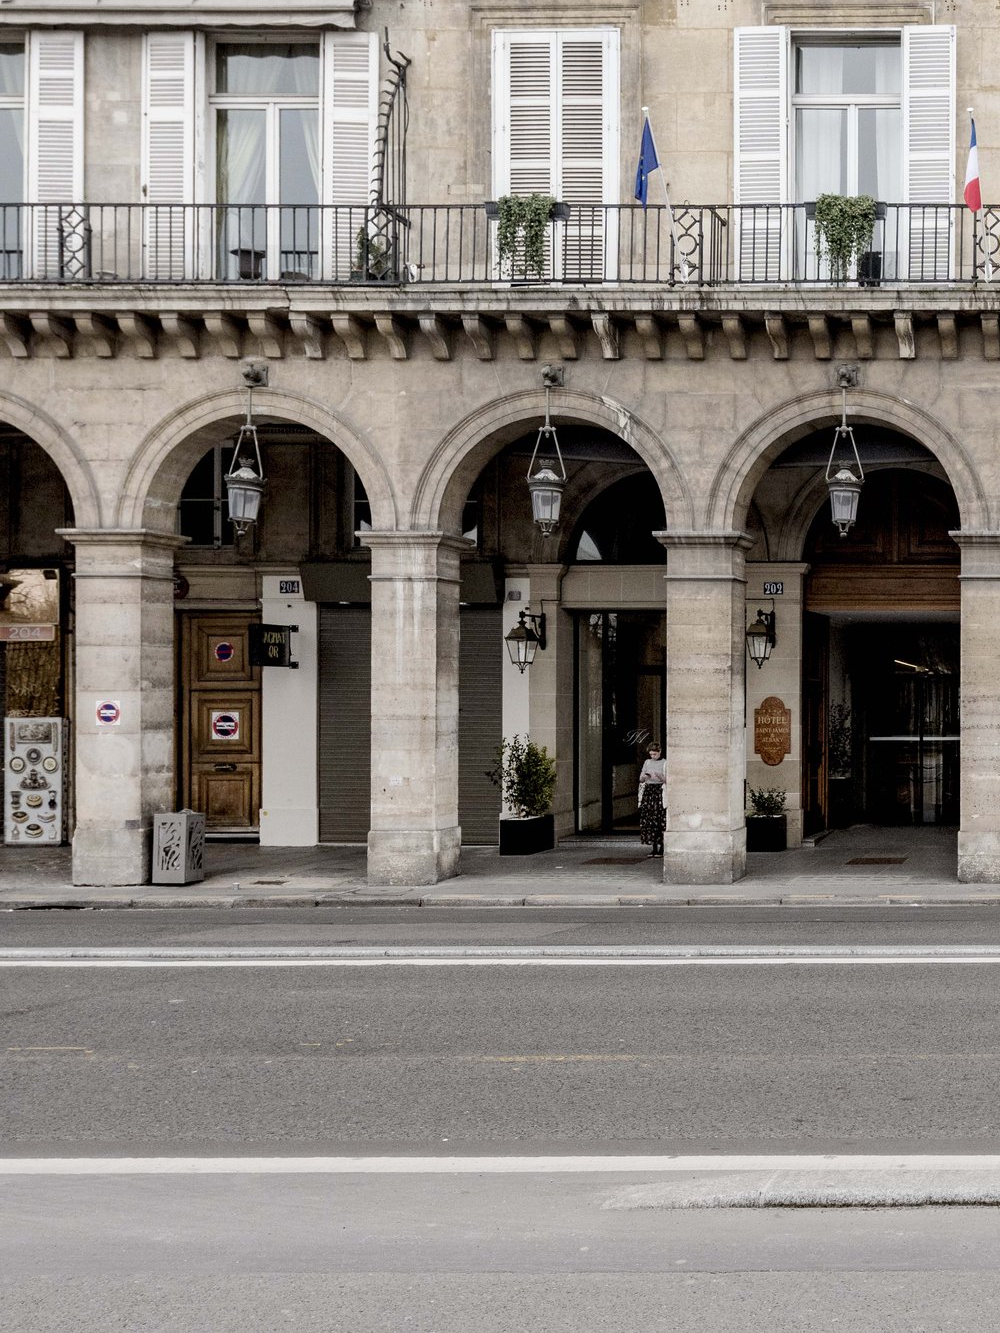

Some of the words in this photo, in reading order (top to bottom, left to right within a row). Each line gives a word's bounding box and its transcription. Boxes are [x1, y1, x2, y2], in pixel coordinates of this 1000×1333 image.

[281, 581, 299, 593] 204
[765, 583, 783, 594] 202
[9, 627, 41, 639] 204
[263, 632, 287, 644] ACHAT
[268, 645, 279, 658] OR
[757, 714, 787, 724] HÔTEL
